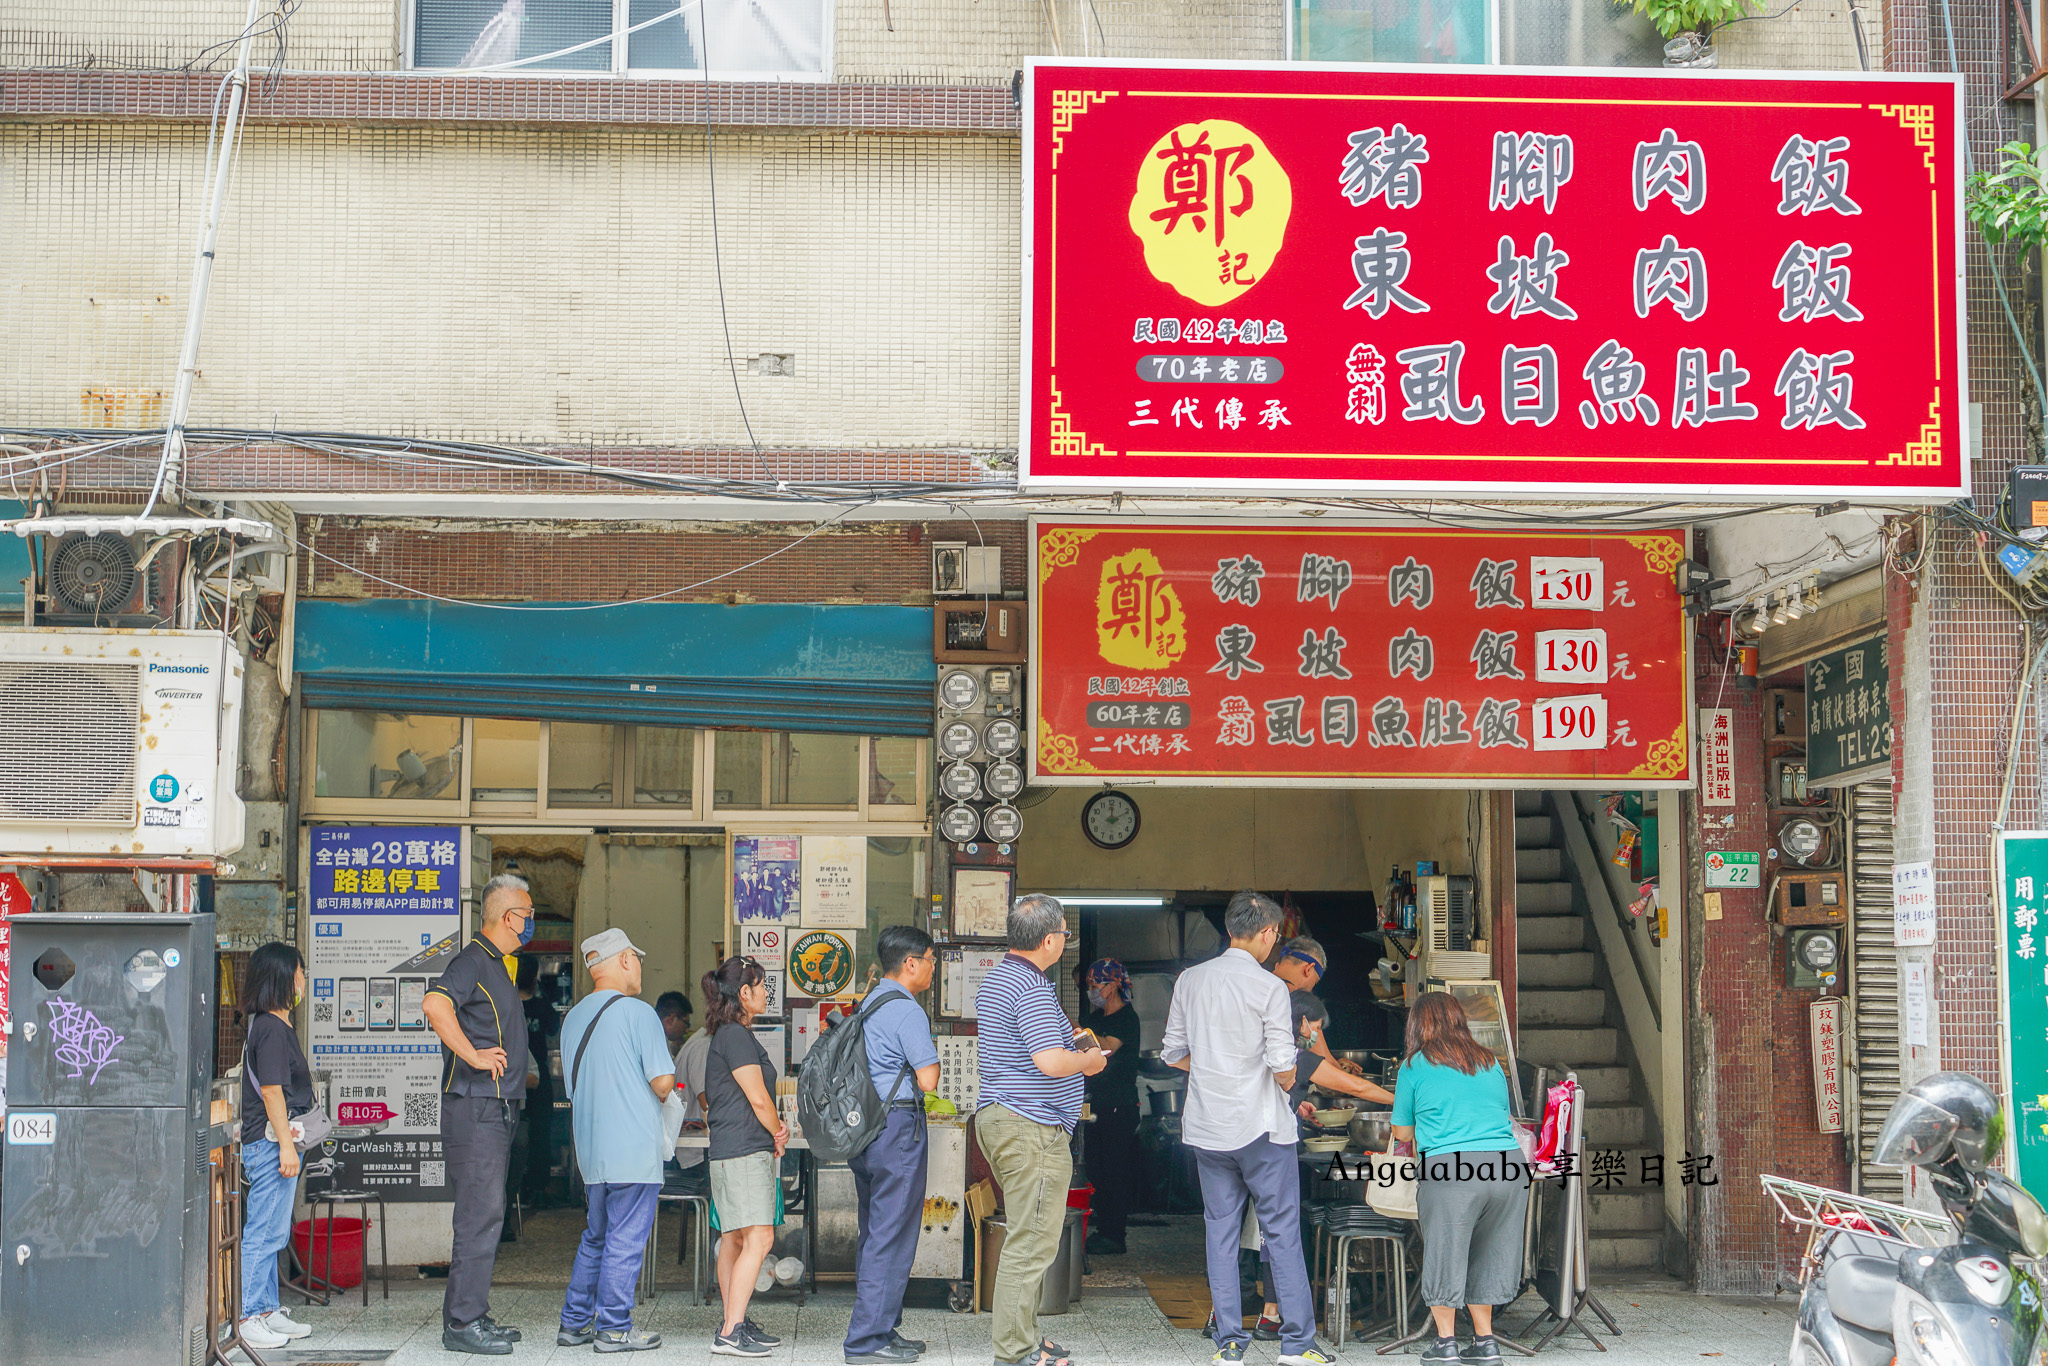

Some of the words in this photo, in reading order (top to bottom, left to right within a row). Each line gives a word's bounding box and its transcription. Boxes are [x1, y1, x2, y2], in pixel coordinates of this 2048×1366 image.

[1339, 123, 1862, 216] 豬腳肉飯
[1149, 130, 1256, 286] 鄭記
[1343, 227, 1864, 322] 東坡肉飯
[1133, 317, 1288, 344] 民國42年創立
[1152, 356, 1269, 382] 70年老店
[1396, 339, 1867, 430] 虱目魚肚飯
[1128, 397, 1292, 431] 三代傳承
[1212, 553, 1524, 611] 豬腳肉飯
[1535, 569, 1592, 601] 130
[1609, 580, 1636, 608] 元
[1102, 562, 1181, 658] 鄭記
[1207, 624, 1525, 680] 東坡肉飯
[1543, 639, 1598, 672] 130
[1610, 653, 1637, 680] 元
[149, 663, 209, 674] Panasonic
[1088, 677, 1190, 696] 民國42年創立
[1096, 705, 1182, 726] 60年老店
[1264, 695, 1528, 749] 虱目魚肚飯
[1541, 705, 1596, 739] 190
[1610, 719, 1638, 747] 元
[1089, 734, 1192, 755] 二代傳承
[1715, 714, 1731, 799] 海洲出版社
[316, 840, 457, 866] 全台灣28萬格
[333, 868, 440, 893] 路邊停車
[1729, 867, 1749, 882] 22
[318, 924, 340, 935] 優惠
[2014, 876, 2037, 960] 用郵票
[796, 934, 822, 953] TAIWAN
[823, 934, 844, 951] PORK
[340, 1086, 387, 1098] 註冊會員
[341, 1106, 383, 1119] 領10元
[13, 1119, 52, 1138] 084
